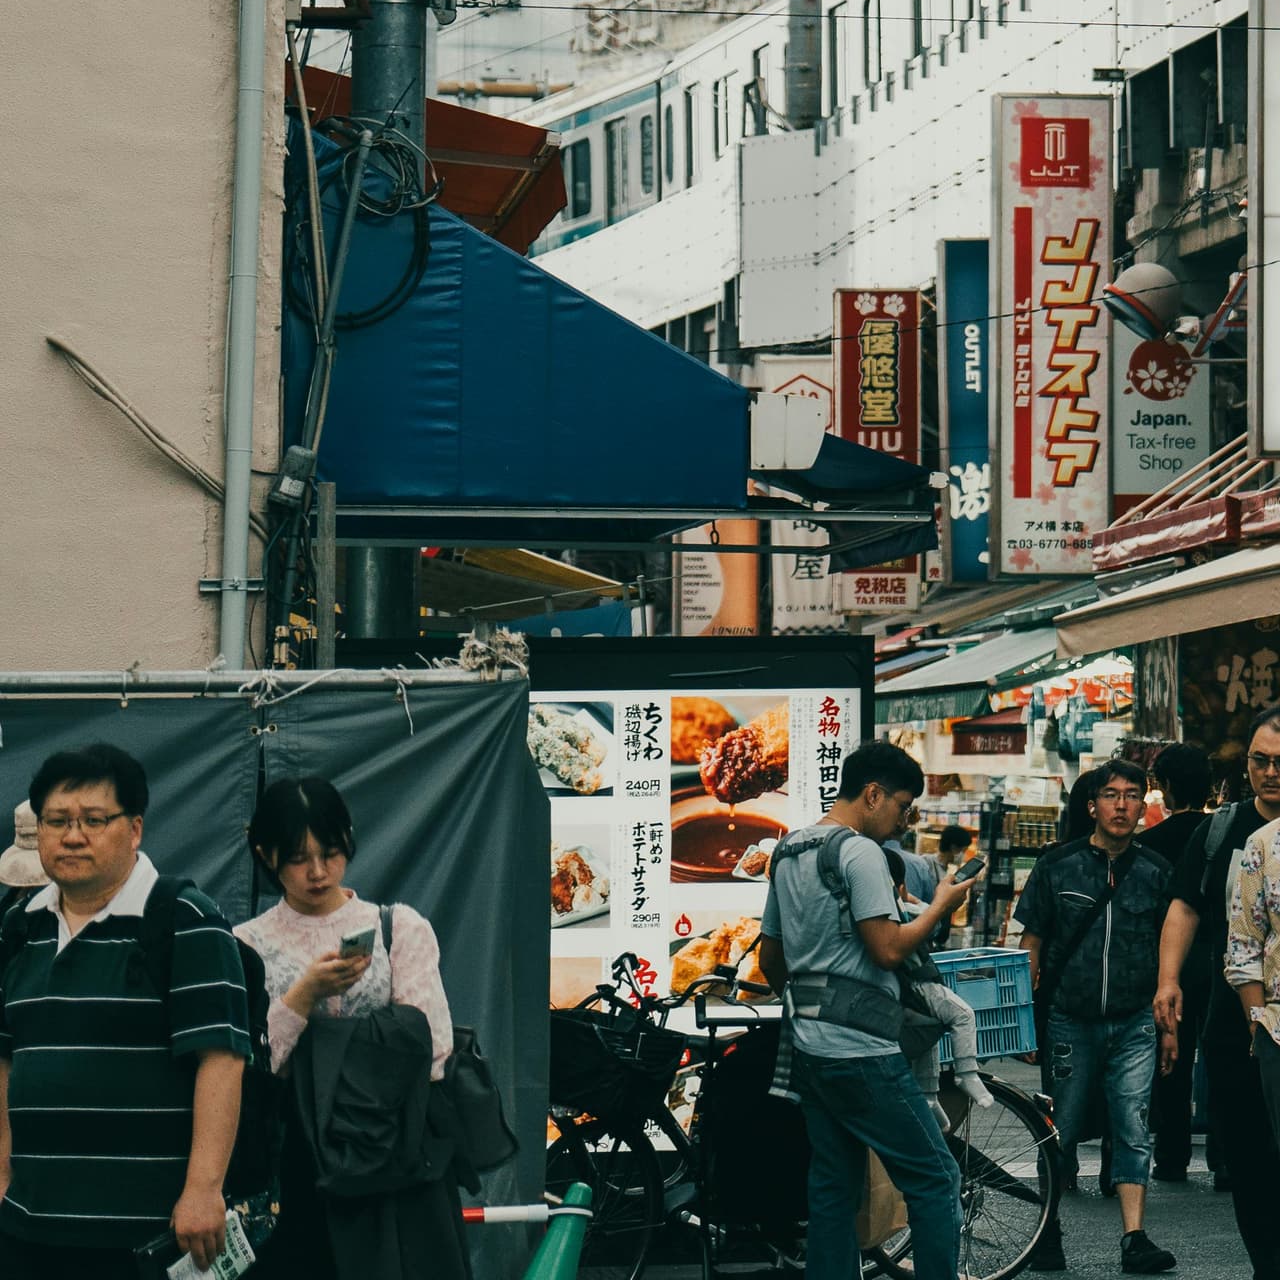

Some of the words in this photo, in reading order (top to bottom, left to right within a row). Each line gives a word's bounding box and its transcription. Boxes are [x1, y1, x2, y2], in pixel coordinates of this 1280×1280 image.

[1030, 165, 1080, 177] JJT
[1015, 297, 1031, 336] JJT
[964, 323, 982, 393] OUTLET
[1041, 218, 1100, 489] JJTストア
[1014, 344, 1031, 408] STORE
[1130, 410, 1193, 432] Japan.
[1126, 433, 1196, 451] Tax-free
[1139, 454, 1183, 474] Shop
[1024, 521, 1057, 532] アメ横
[1060, 521, 1085, 532] 本店
[854, 577, 906, 595] 免税店
[854, 596, 875, 605] TAX
[878, 596, 906, 605] FREE
[818, 696, 841, 738] 名物
[624, 703, 643, 762] 磯辺揚げ
[642, 702, 664, 760] ちくわ
[625, 779, 661, 791] 240円
[649, 821, 664, 865] 一軒めの
[632, 913, 661, 923] 290円
